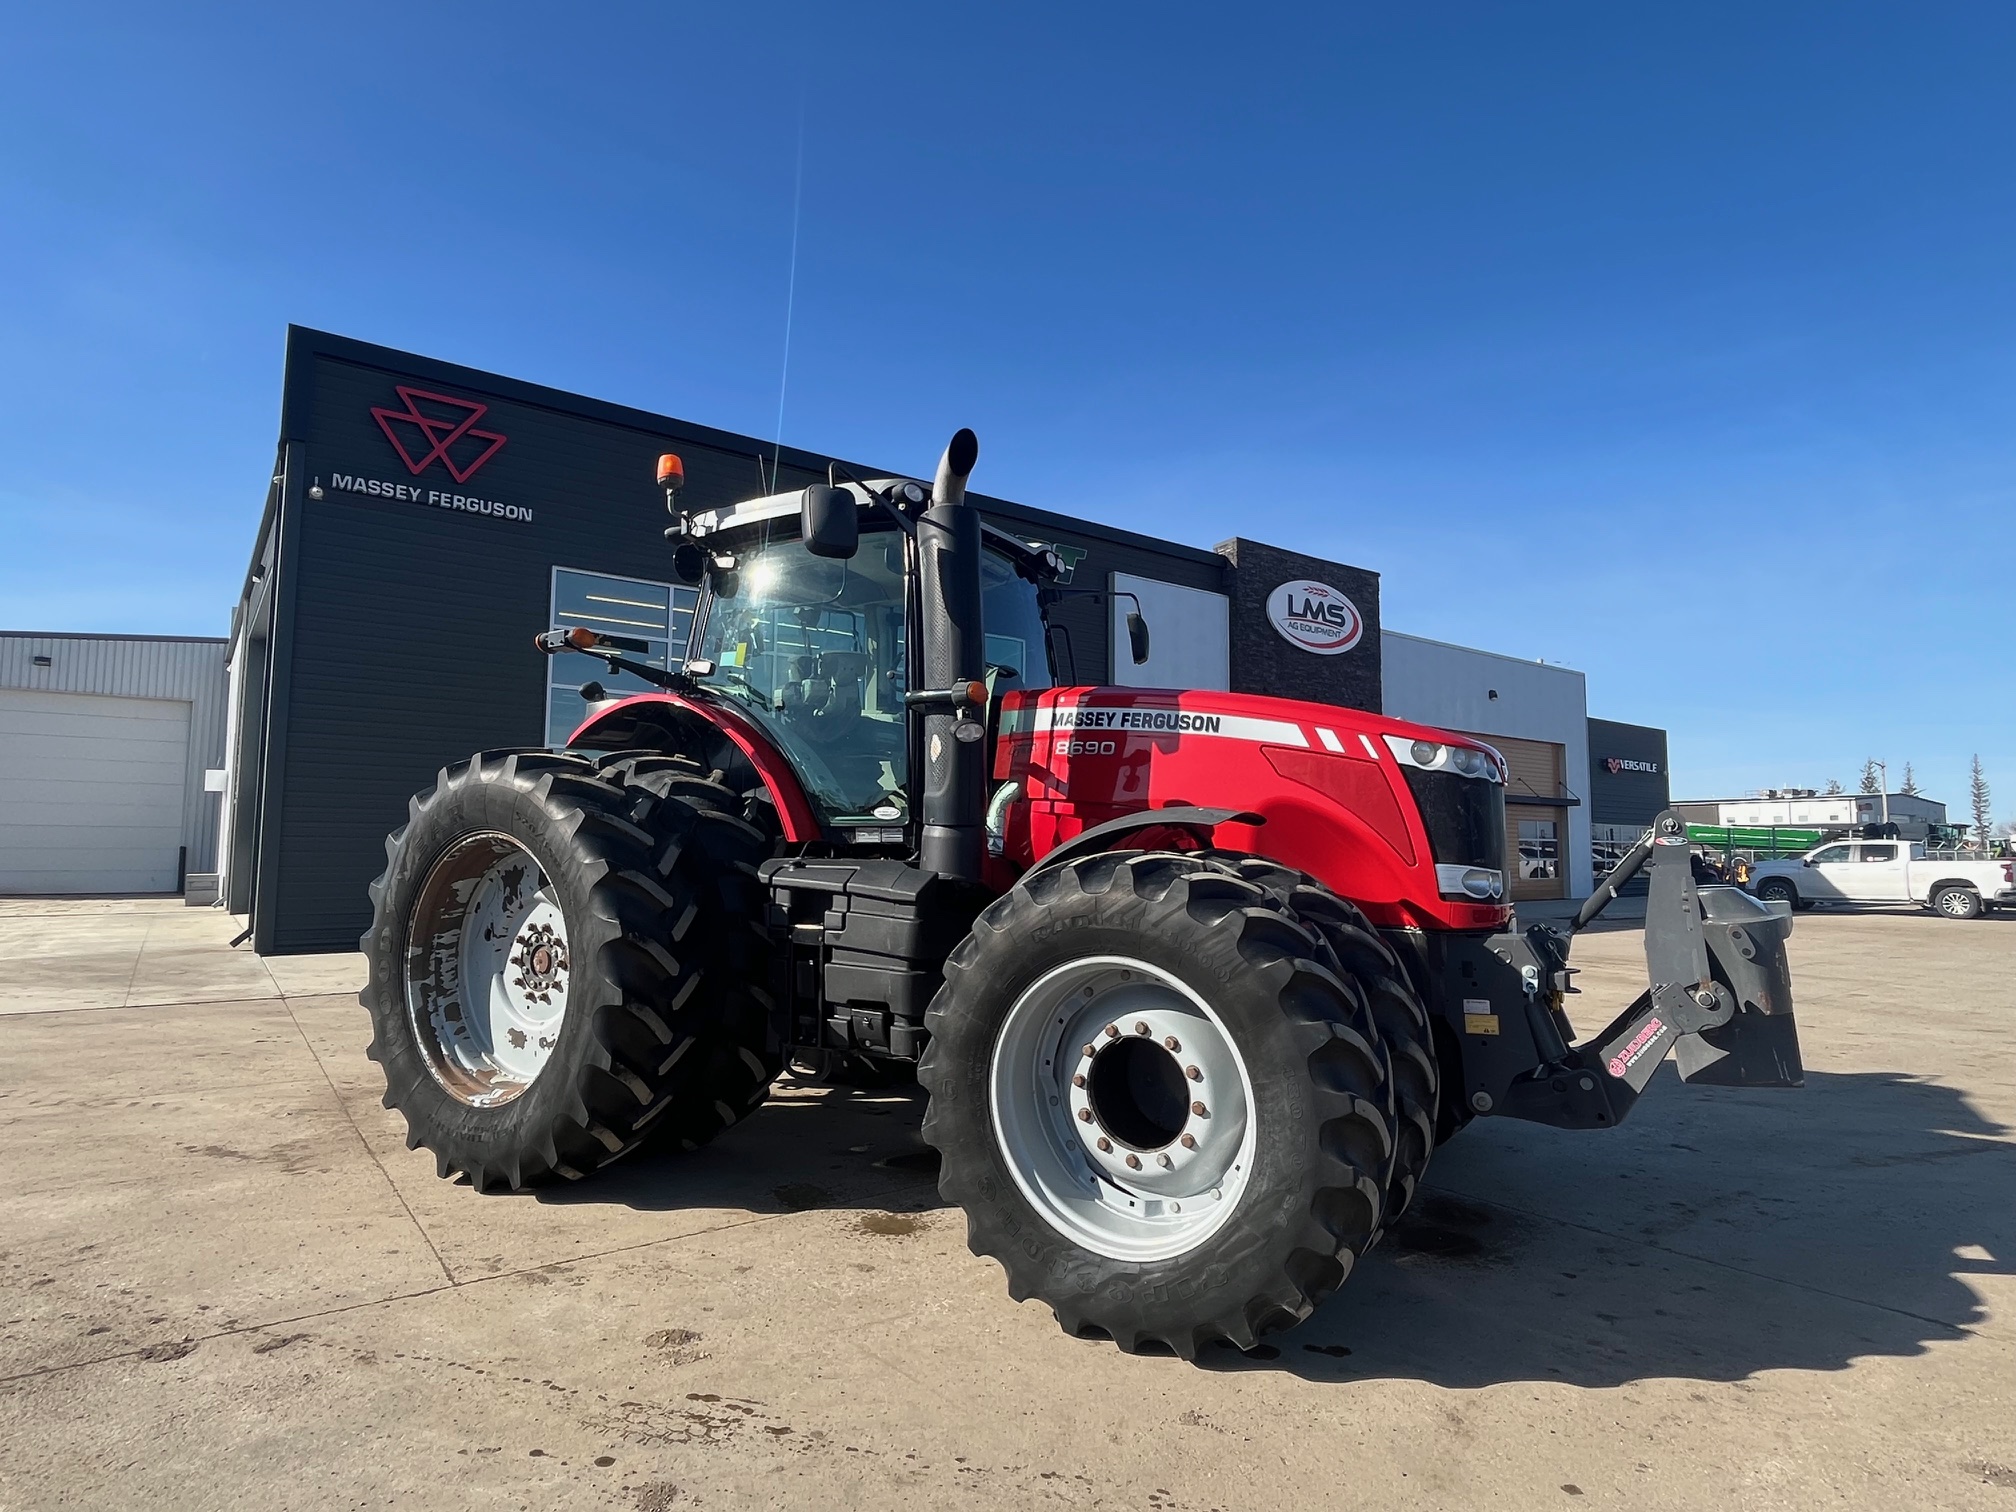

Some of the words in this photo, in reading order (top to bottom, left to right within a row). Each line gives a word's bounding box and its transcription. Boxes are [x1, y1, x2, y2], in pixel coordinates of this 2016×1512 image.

[331, 472, 422, 503] MASSEY
[428, 490, 534, 523] FERGUSON
[1287, 593, 1346, 628] LMS
[1287, 621, 1299, 631] AG
[1300, 624, 1342, 639] EQUIPMENT
[1051, 711, 1117, 728] MASSEY
[1120, 712, 1221, 734] FERGUSON
[1055, 741, 1116, 756] 8690
[1620, 759, 1658, 773] VERSATILE
